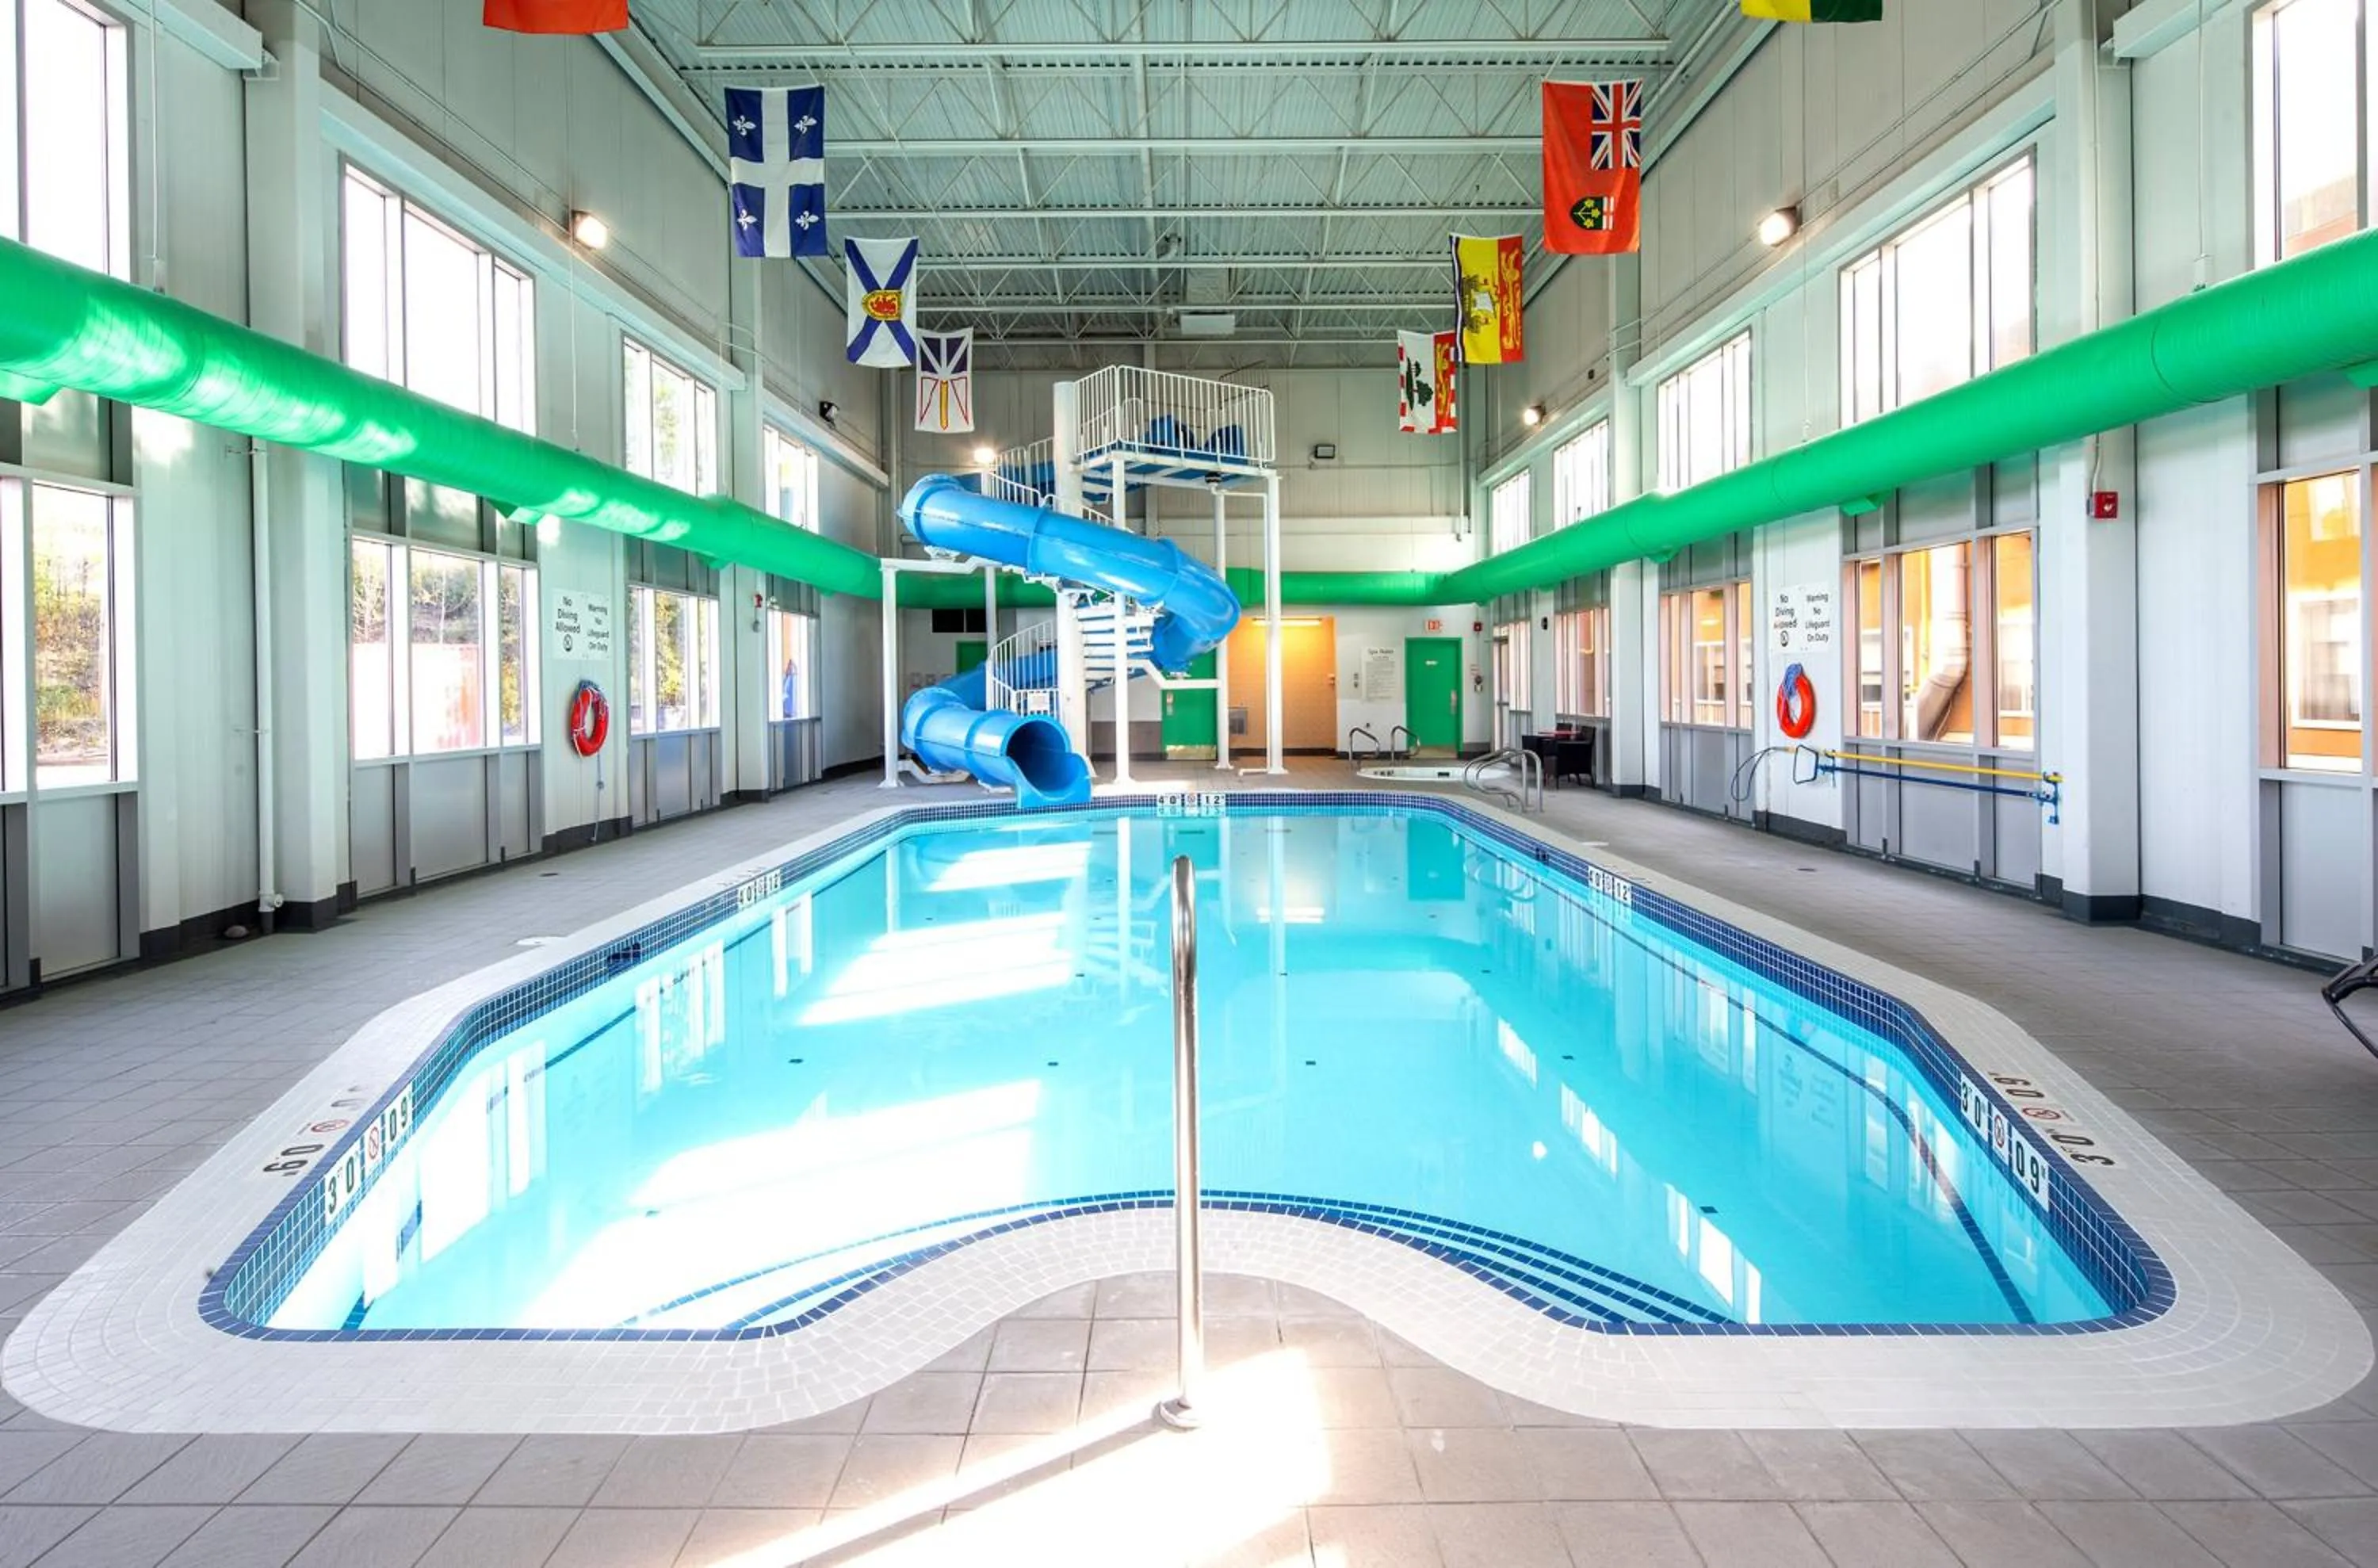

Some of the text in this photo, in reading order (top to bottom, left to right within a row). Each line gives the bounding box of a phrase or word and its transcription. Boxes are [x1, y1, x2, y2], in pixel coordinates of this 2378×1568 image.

[558, 609, 577, 623] Diving
[1776, 607, 1795, 618] Diving
[556, 621, 580, 634] Allowed
